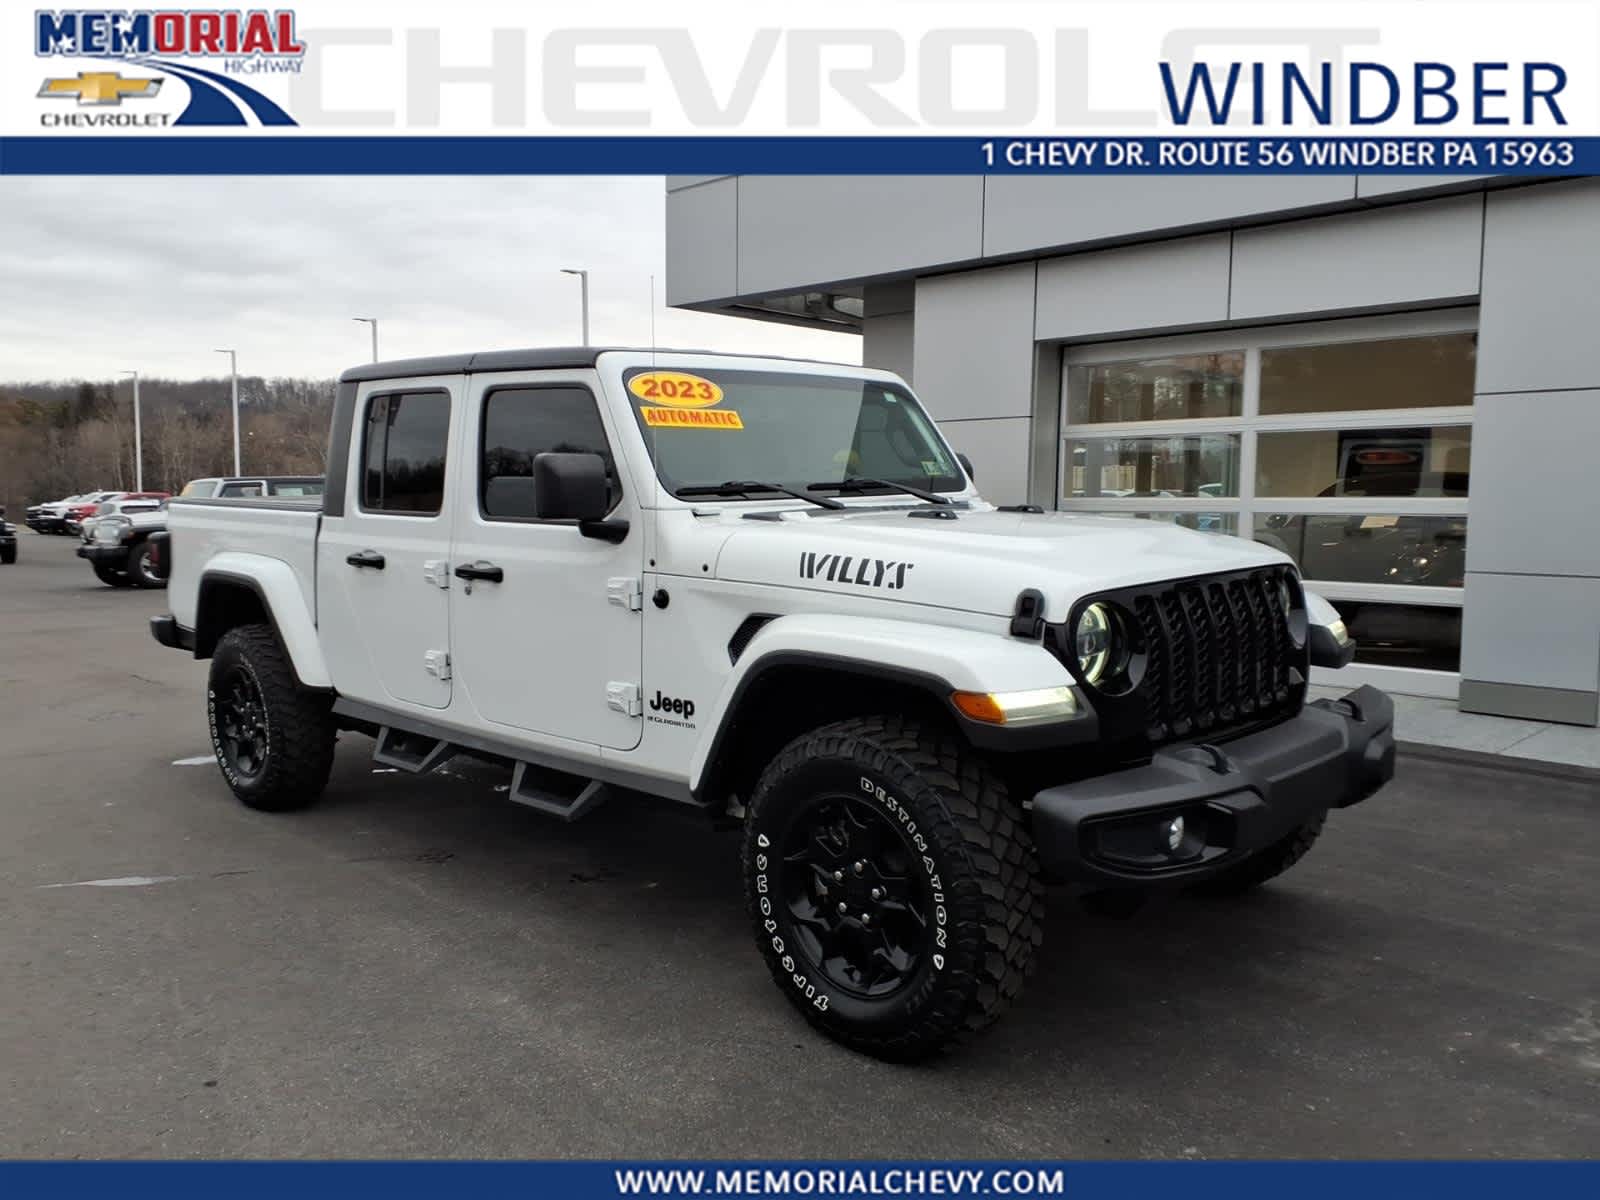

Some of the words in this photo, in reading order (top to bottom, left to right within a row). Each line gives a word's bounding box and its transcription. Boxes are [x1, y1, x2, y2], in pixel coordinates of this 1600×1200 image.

[642, 379, 713, 400] 2023
[647, 409, 738, 425] AUTOMATIC
[800, 552, 914, 589] WILLYS
[650, 690, 695, 719] Jeep
[861, 777, 947, 948] DESTINATION
